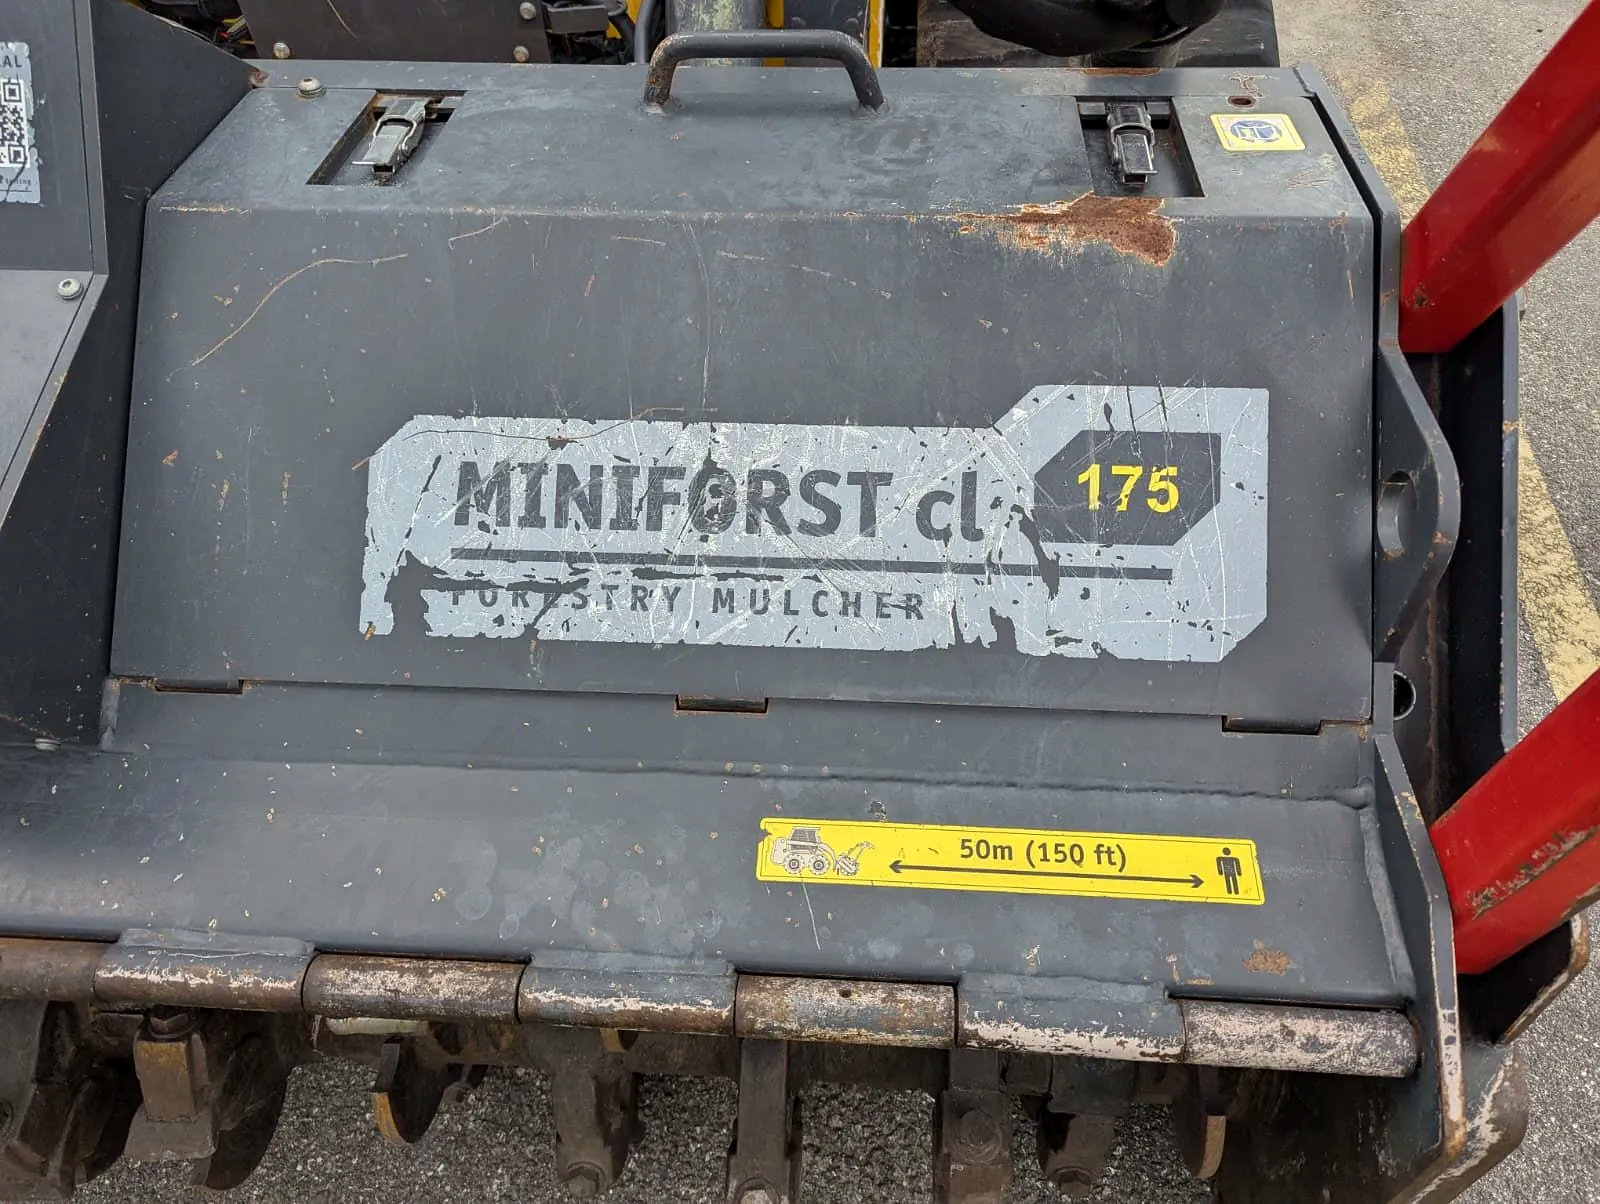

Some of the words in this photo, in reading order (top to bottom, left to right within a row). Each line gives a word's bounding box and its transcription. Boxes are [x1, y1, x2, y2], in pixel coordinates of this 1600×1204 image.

[0, 55, 23, 68] AL
[454, 461, 894, 538] MINIFORST
[915, 471, 985, 542] cl
[1077, 463, 1180, 513] 175
[711, 587, 924, 620] MULCHER
[960, 838, 1014, 861] 50m
[1025, 839, 1085, 869] (150
[1093, 843, 1127, 873] ft)
